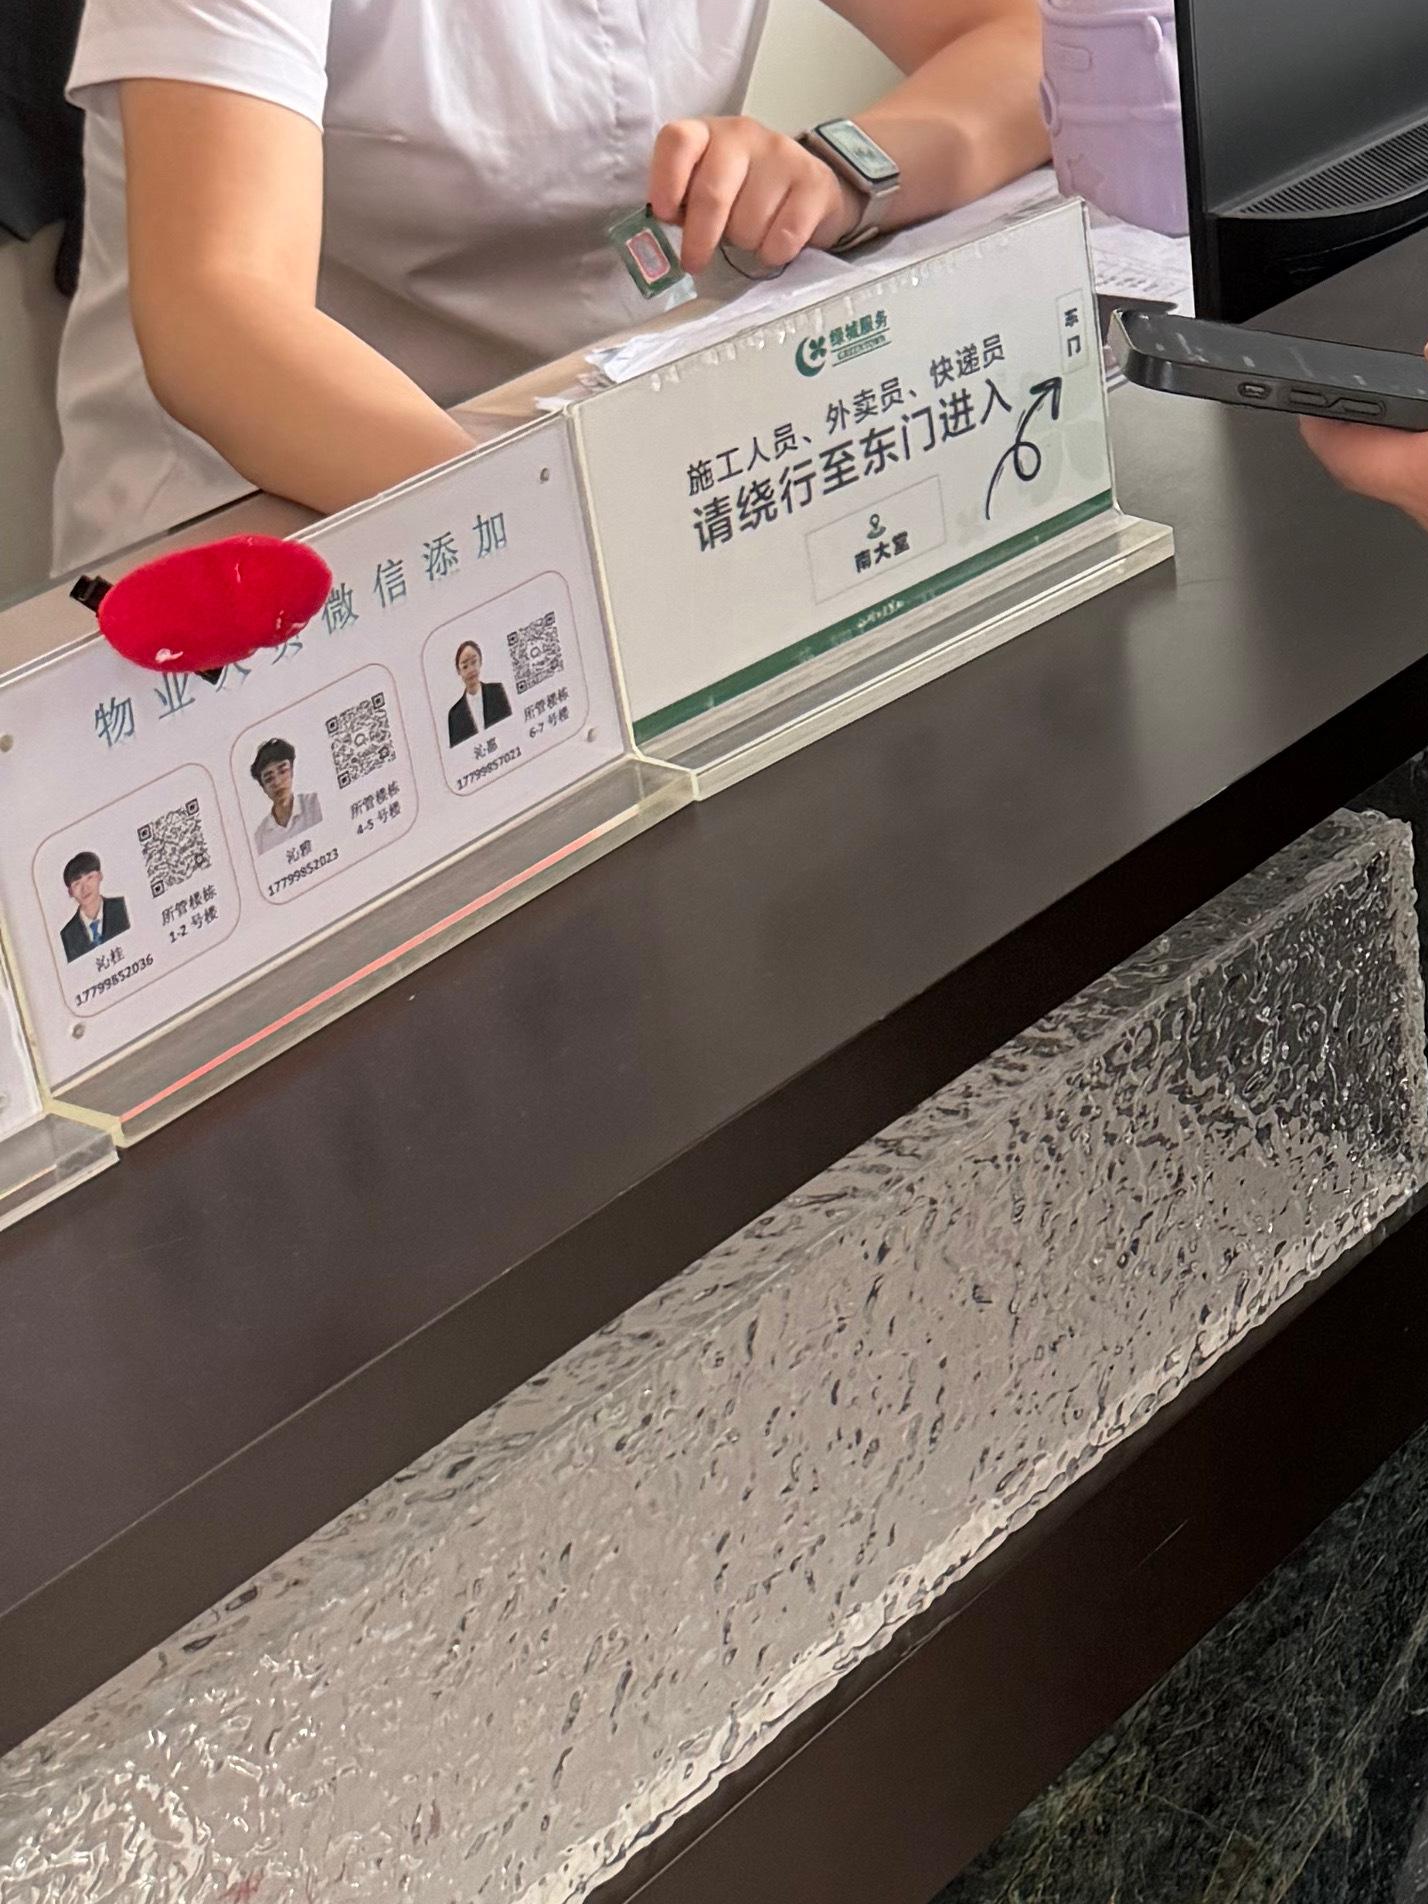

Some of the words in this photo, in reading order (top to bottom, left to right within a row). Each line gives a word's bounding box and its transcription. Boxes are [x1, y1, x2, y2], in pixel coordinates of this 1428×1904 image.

[687, 333, 1006, 496] 施工人员、外卖员、快递员
[693, 377, 1013, 553] 请绕行至东门进入
[94, 512, 508, 747] 物业微信添加
